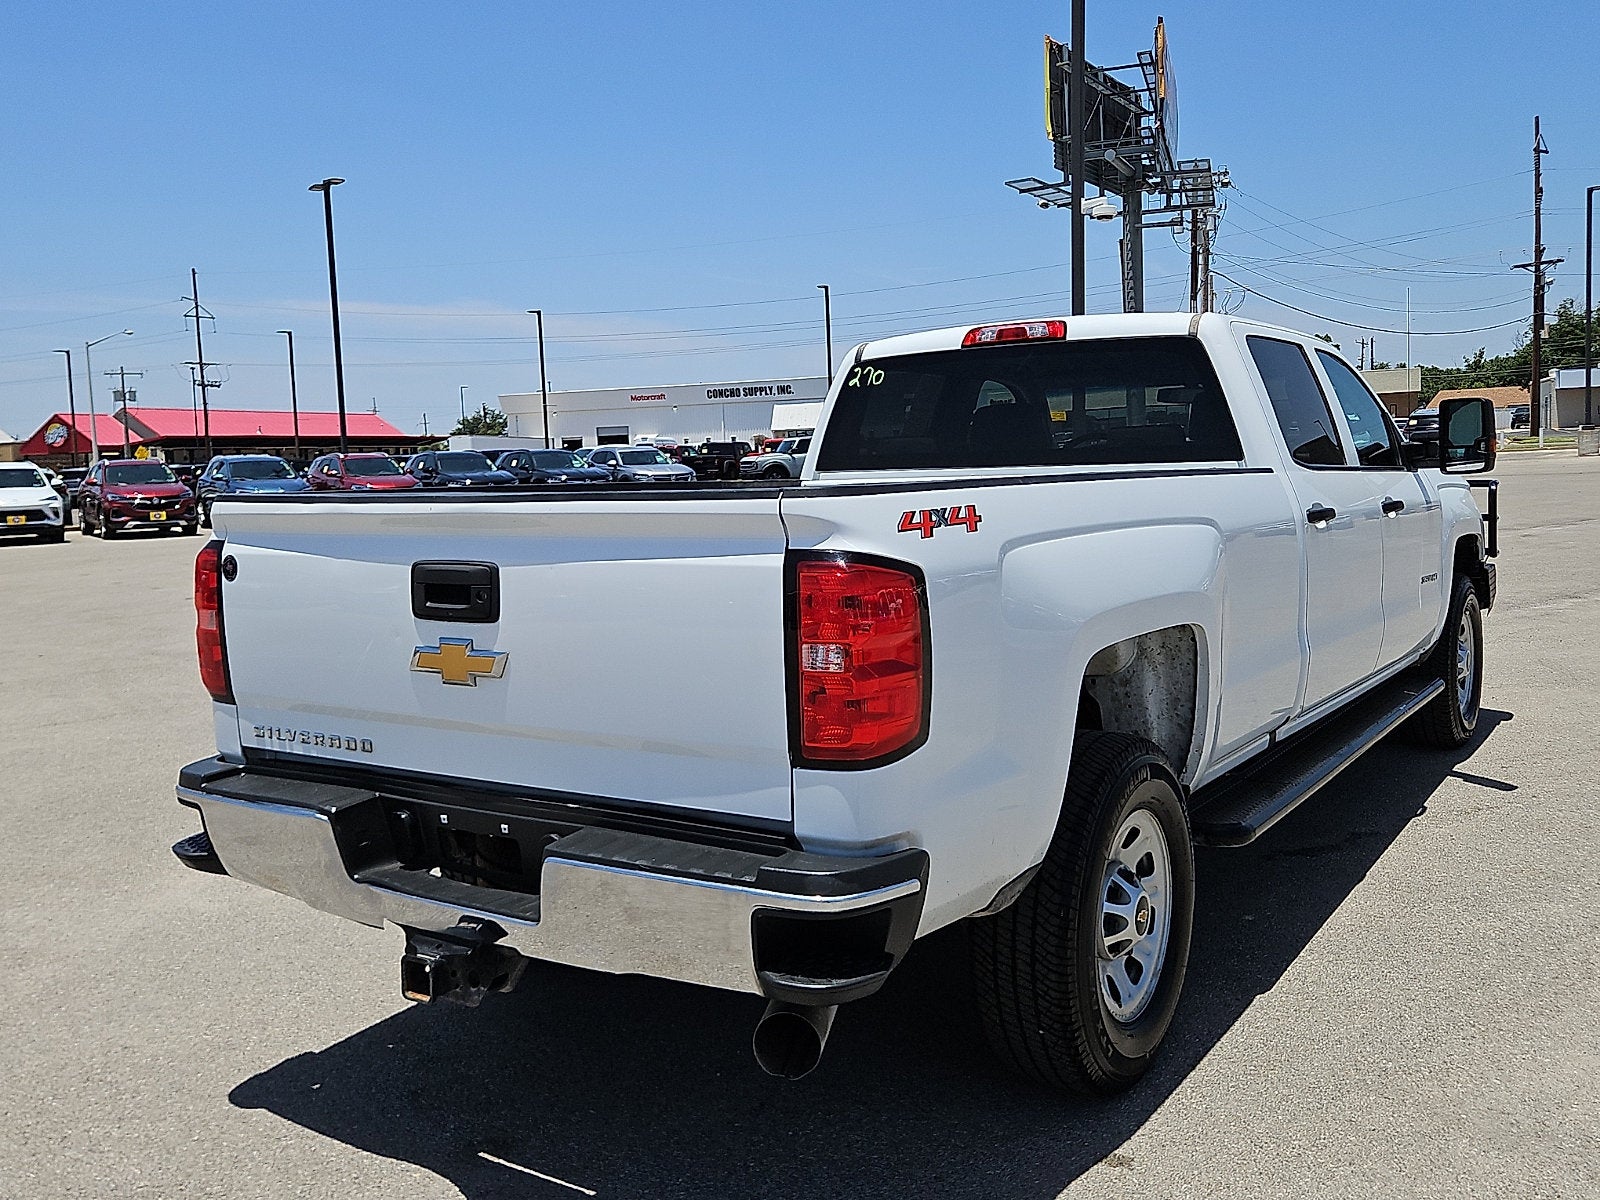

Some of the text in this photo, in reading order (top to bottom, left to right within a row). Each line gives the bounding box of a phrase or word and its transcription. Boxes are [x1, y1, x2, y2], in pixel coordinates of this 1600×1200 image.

[848, 366, 885, 388] 270
[630, 393, 666, 402] Motorcraft
[706, 384, 795, 399] CONCHO SUPPLY, INC.
[253, 725, 373, 753] SILVERADO
